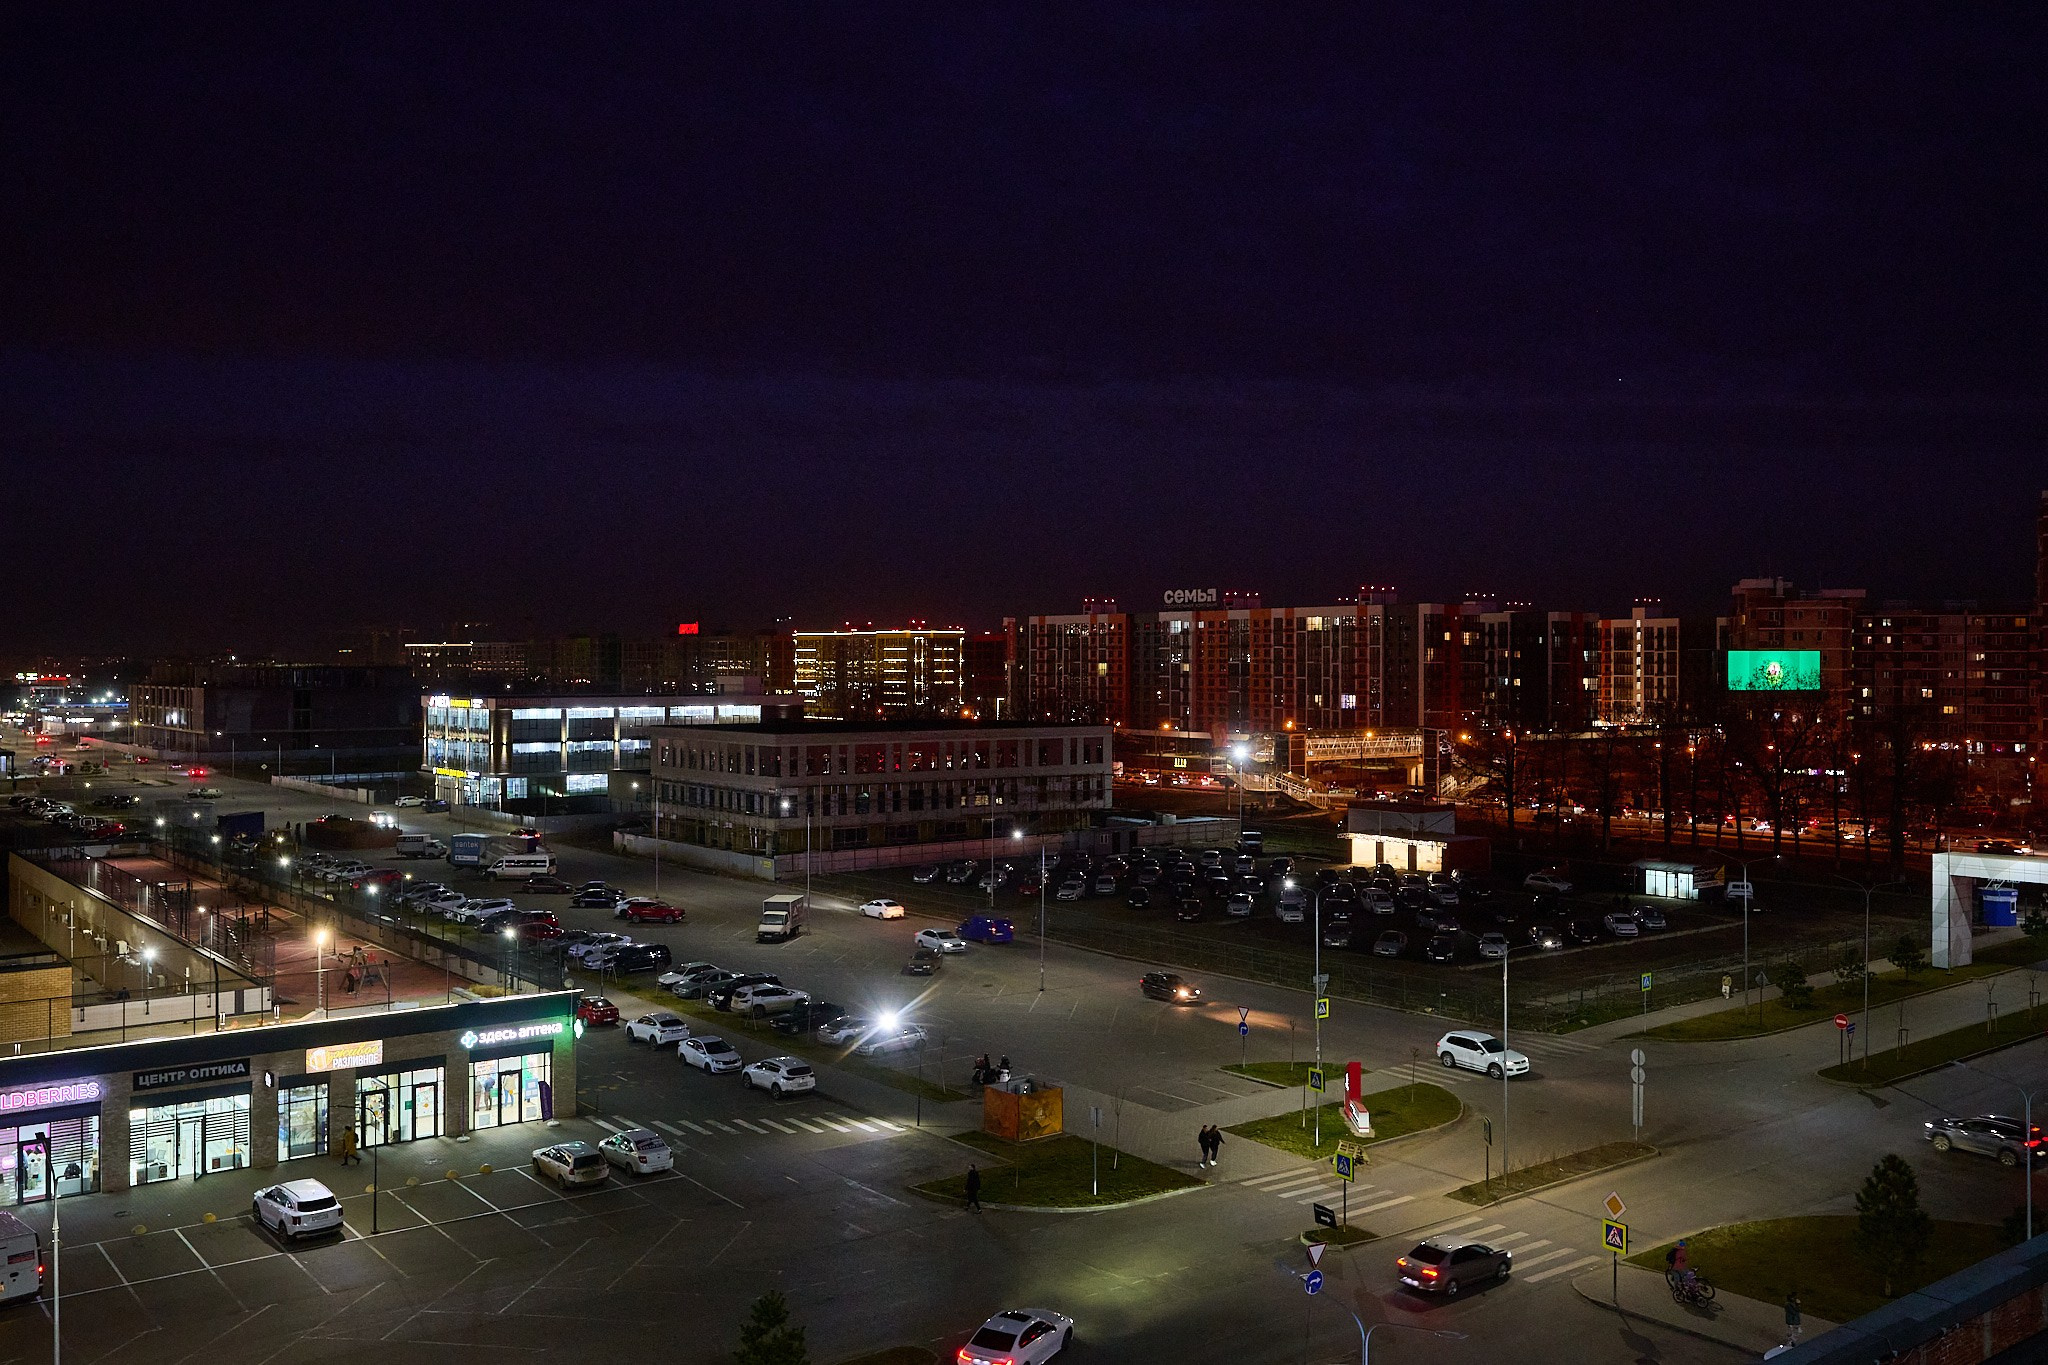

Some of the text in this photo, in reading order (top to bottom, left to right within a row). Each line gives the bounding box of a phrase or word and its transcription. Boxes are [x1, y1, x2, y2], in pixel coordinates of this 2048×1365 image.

[478, 1022, 563, 1044] здесь аптека
[332, 1053, 379, 1069] РАЗЛИВНОЕ
[138, 1062, 245, 1087] ЦЕНТР ОПТИКА
[0, 1082, 100, 1110] LDBERRIES
